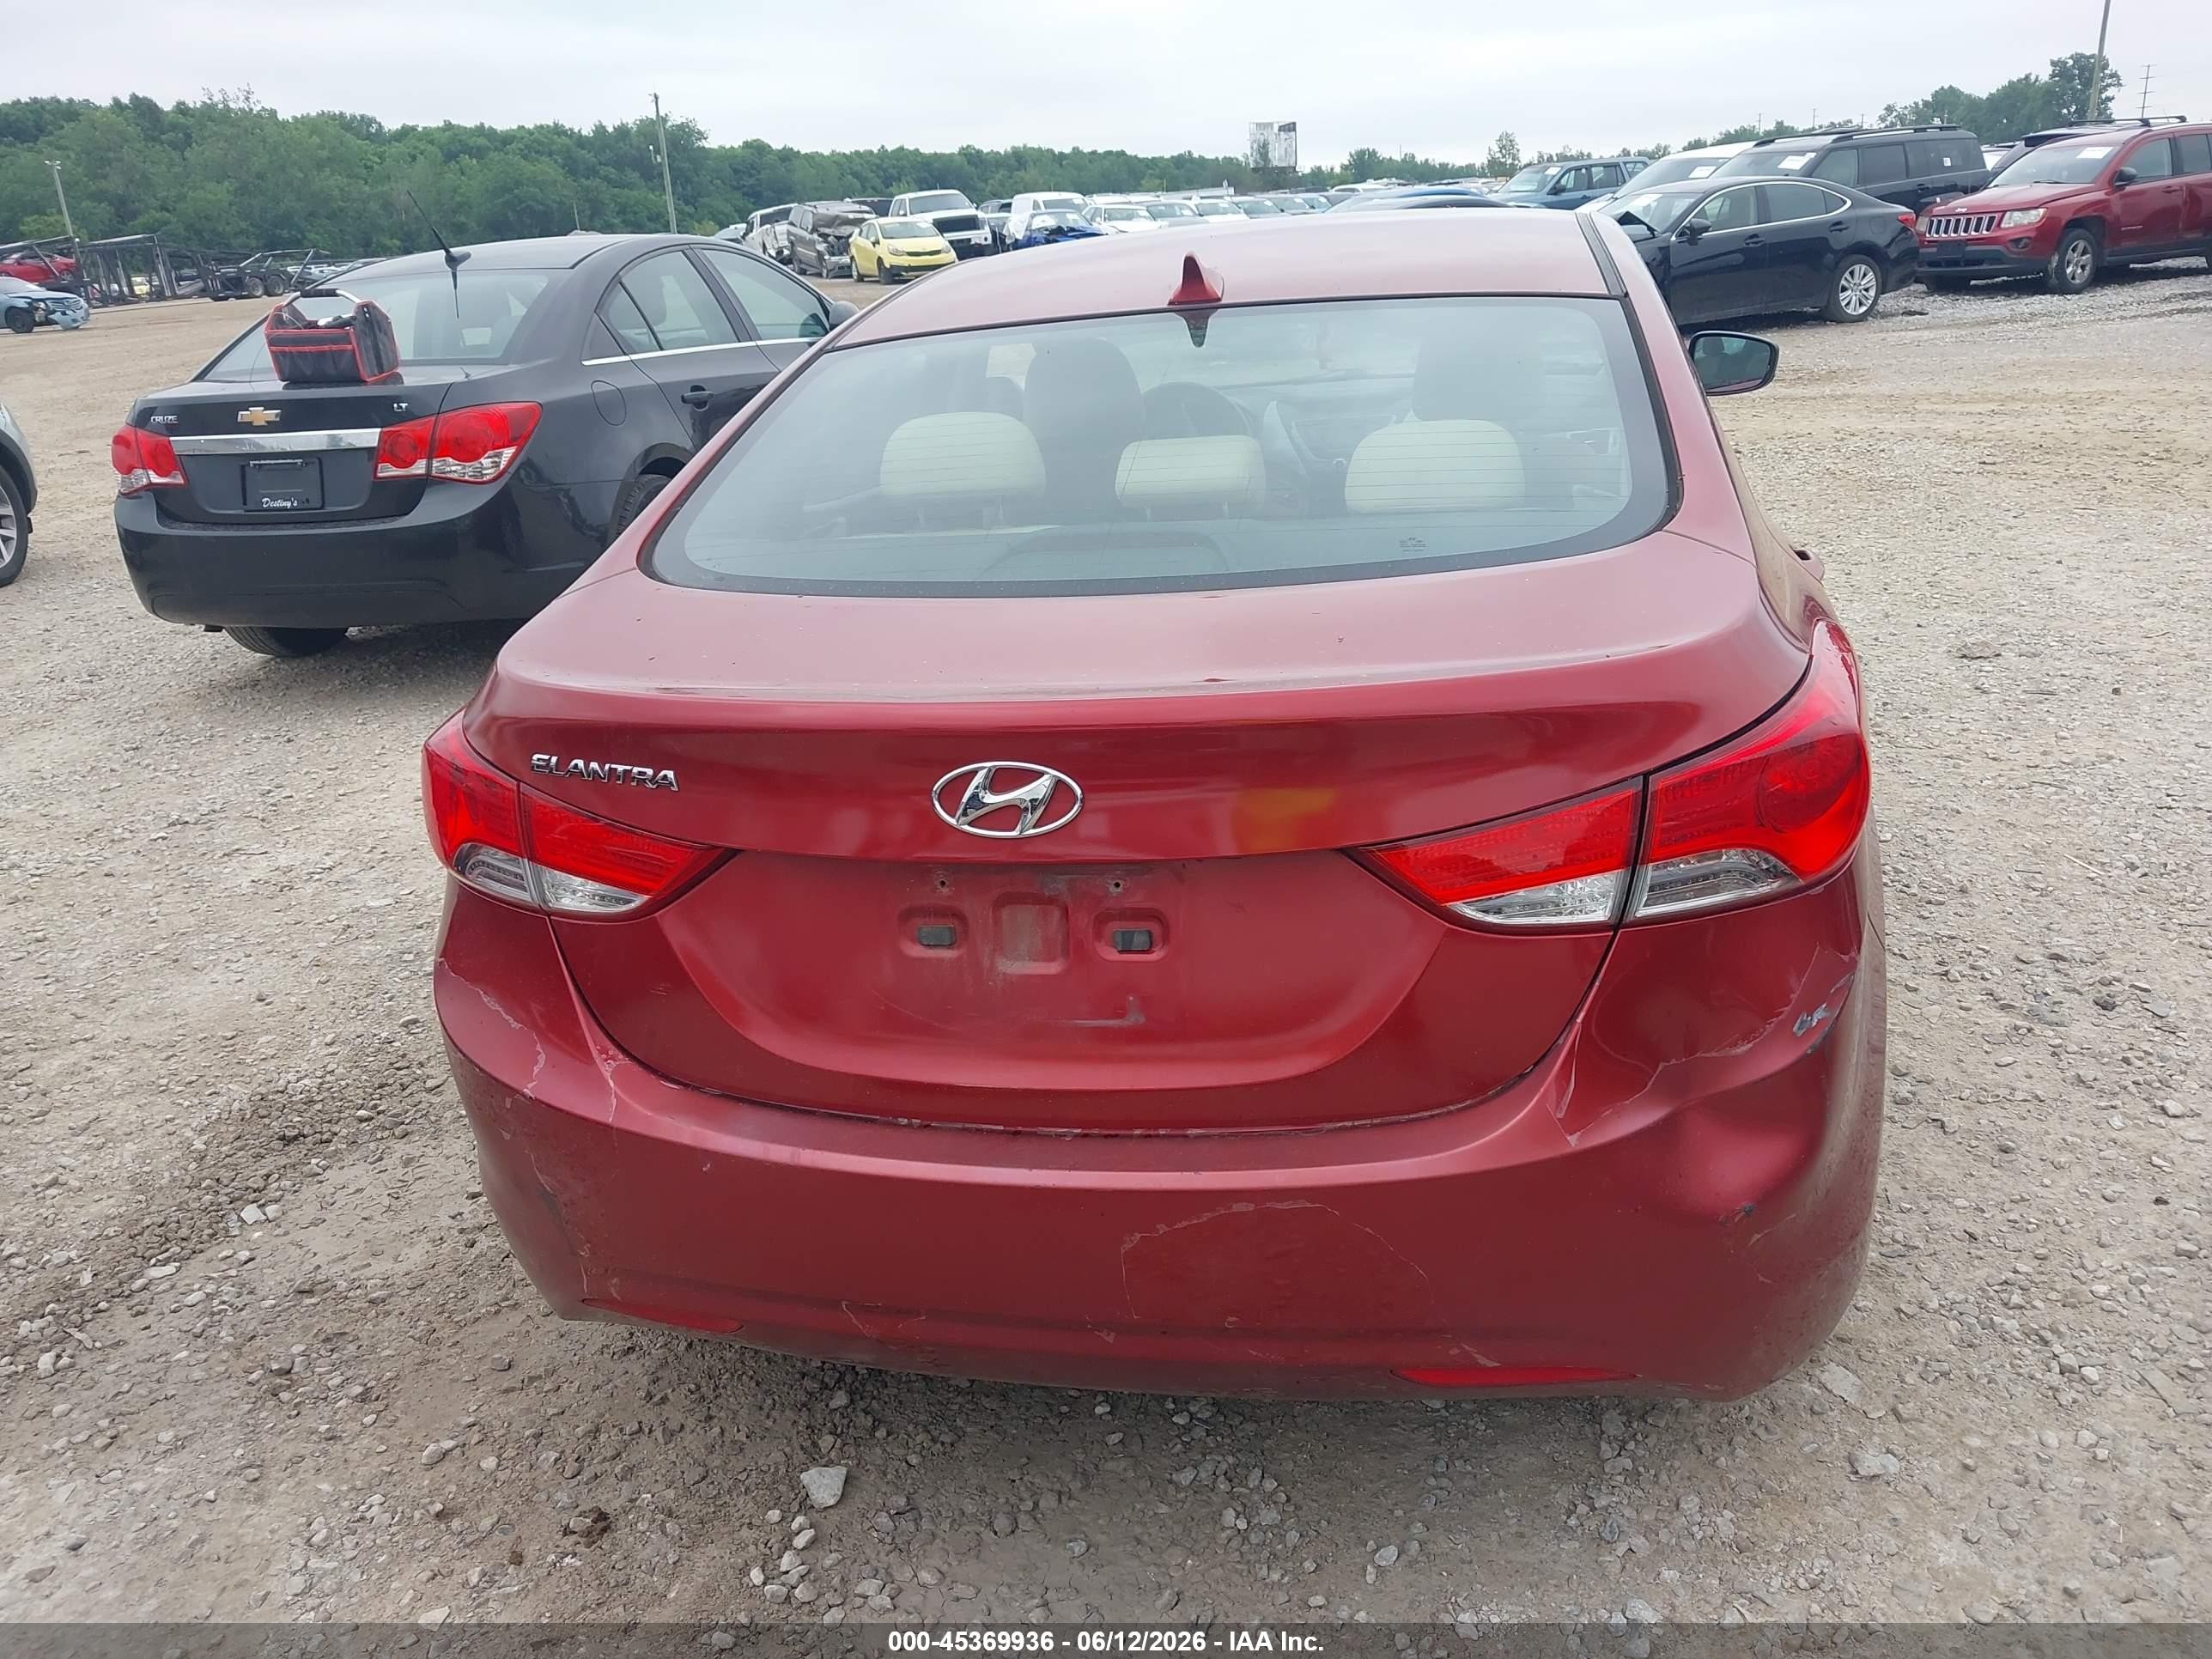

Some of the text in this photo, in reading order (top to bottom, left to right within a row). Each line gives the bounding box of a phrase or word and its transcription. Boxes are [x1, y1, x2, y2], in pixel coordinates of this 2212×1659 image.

[393, 403, 408, 411] LT
[150, 416, 179, 424] CRUZE
[261, 497, 298, 509] Destiny's
[531, 753, 679, 792] ELANTRA
